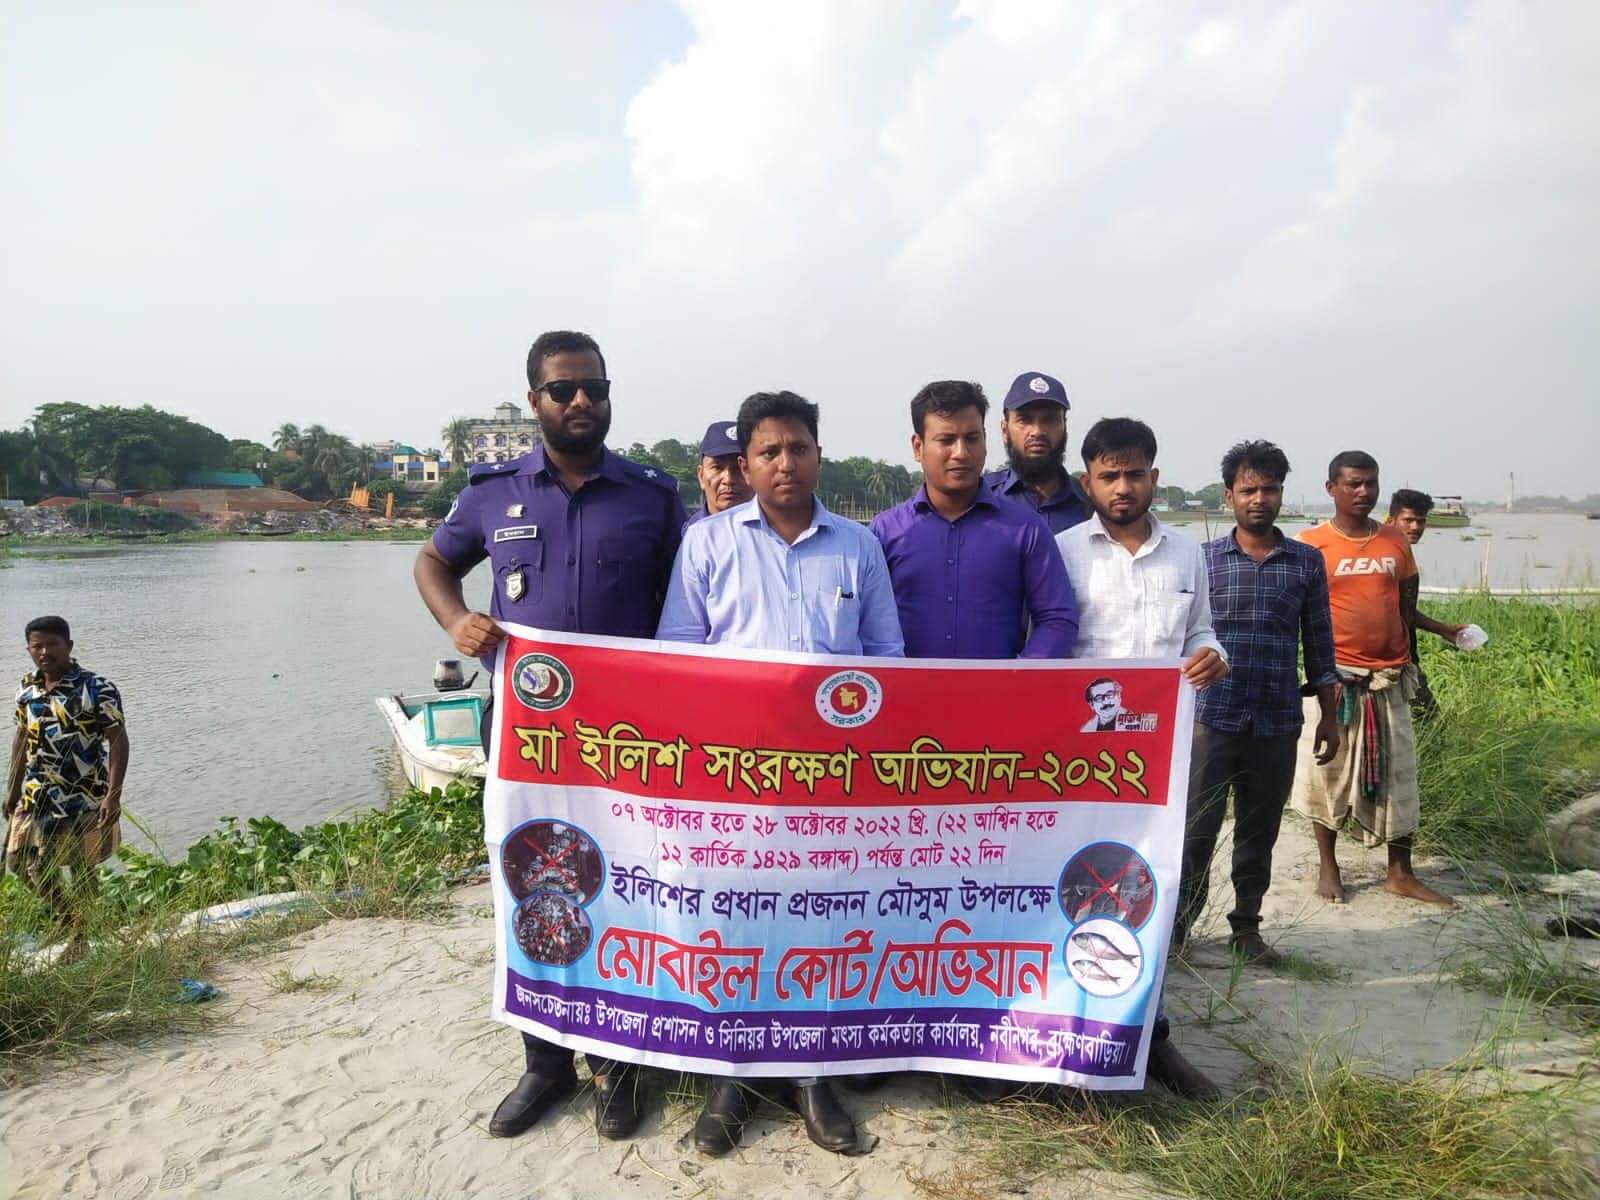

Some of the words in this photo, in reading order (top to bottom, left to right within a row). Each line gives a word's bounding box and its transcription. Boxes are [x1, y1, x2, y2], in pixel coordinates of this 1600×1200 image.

[1333, 557, 1396, 577] GEAR
[513, 721, 565, 775] মা
[574, 719, 690, 788] ইলিশ
[702, 743, 863, 797] সংরক্ষণ
[870, 736, 1150, 798] অভিযান-২০২২
[611, 802, 635, 822] ০৭
[640, 803, 704, 831] অক্টোবর
[710, 811, 746, 834] হতে
[752, 814, 778, 836] ২৮
[784, 810, 848, 835] অক্টোবর
[854, 814, 901, 837] ২০২২
[936, 812, 968, 838] (২২
[974, 806, 1019, 832] আশ্বিন
[1025, 810, 1058, 830] হতে
[660, 842, 683, 864] ১২
[688, 839, 747, 867] কার্তিক
[752, 849, 801, 871] ১৪২৯
[866, 841, 905, 870] পর্যন্ত
[910, 840, 945, 868] মোট
[949, 846, 973, 868] ২২
[978, 838, 1007, 865] দিন
[610, 861, 705, 918] ইলিশের
[712, 887, 782, 921] প্রধান
[787, 888, 871, 921] প্রজনন
[877, 876, 953, 923] মৌসুম
[958, 875, 1056, 914] উপলক্ষে
[596, 926, 765, 1008] মোবাইল
[595, 996, 649, 1040] উপজেলা
[652, 1015, 701, 1046] প্রশাসন
[704, 1025, 714, 1045] ও
[718, 1018, 766, 1053] সিনিয়র
[770, 1017, 827, 1051] উপজেলা
[831, 1022, 864, 1050] মৎস্য
[868, 1013, 926, 1048] কর্মকর্তার
